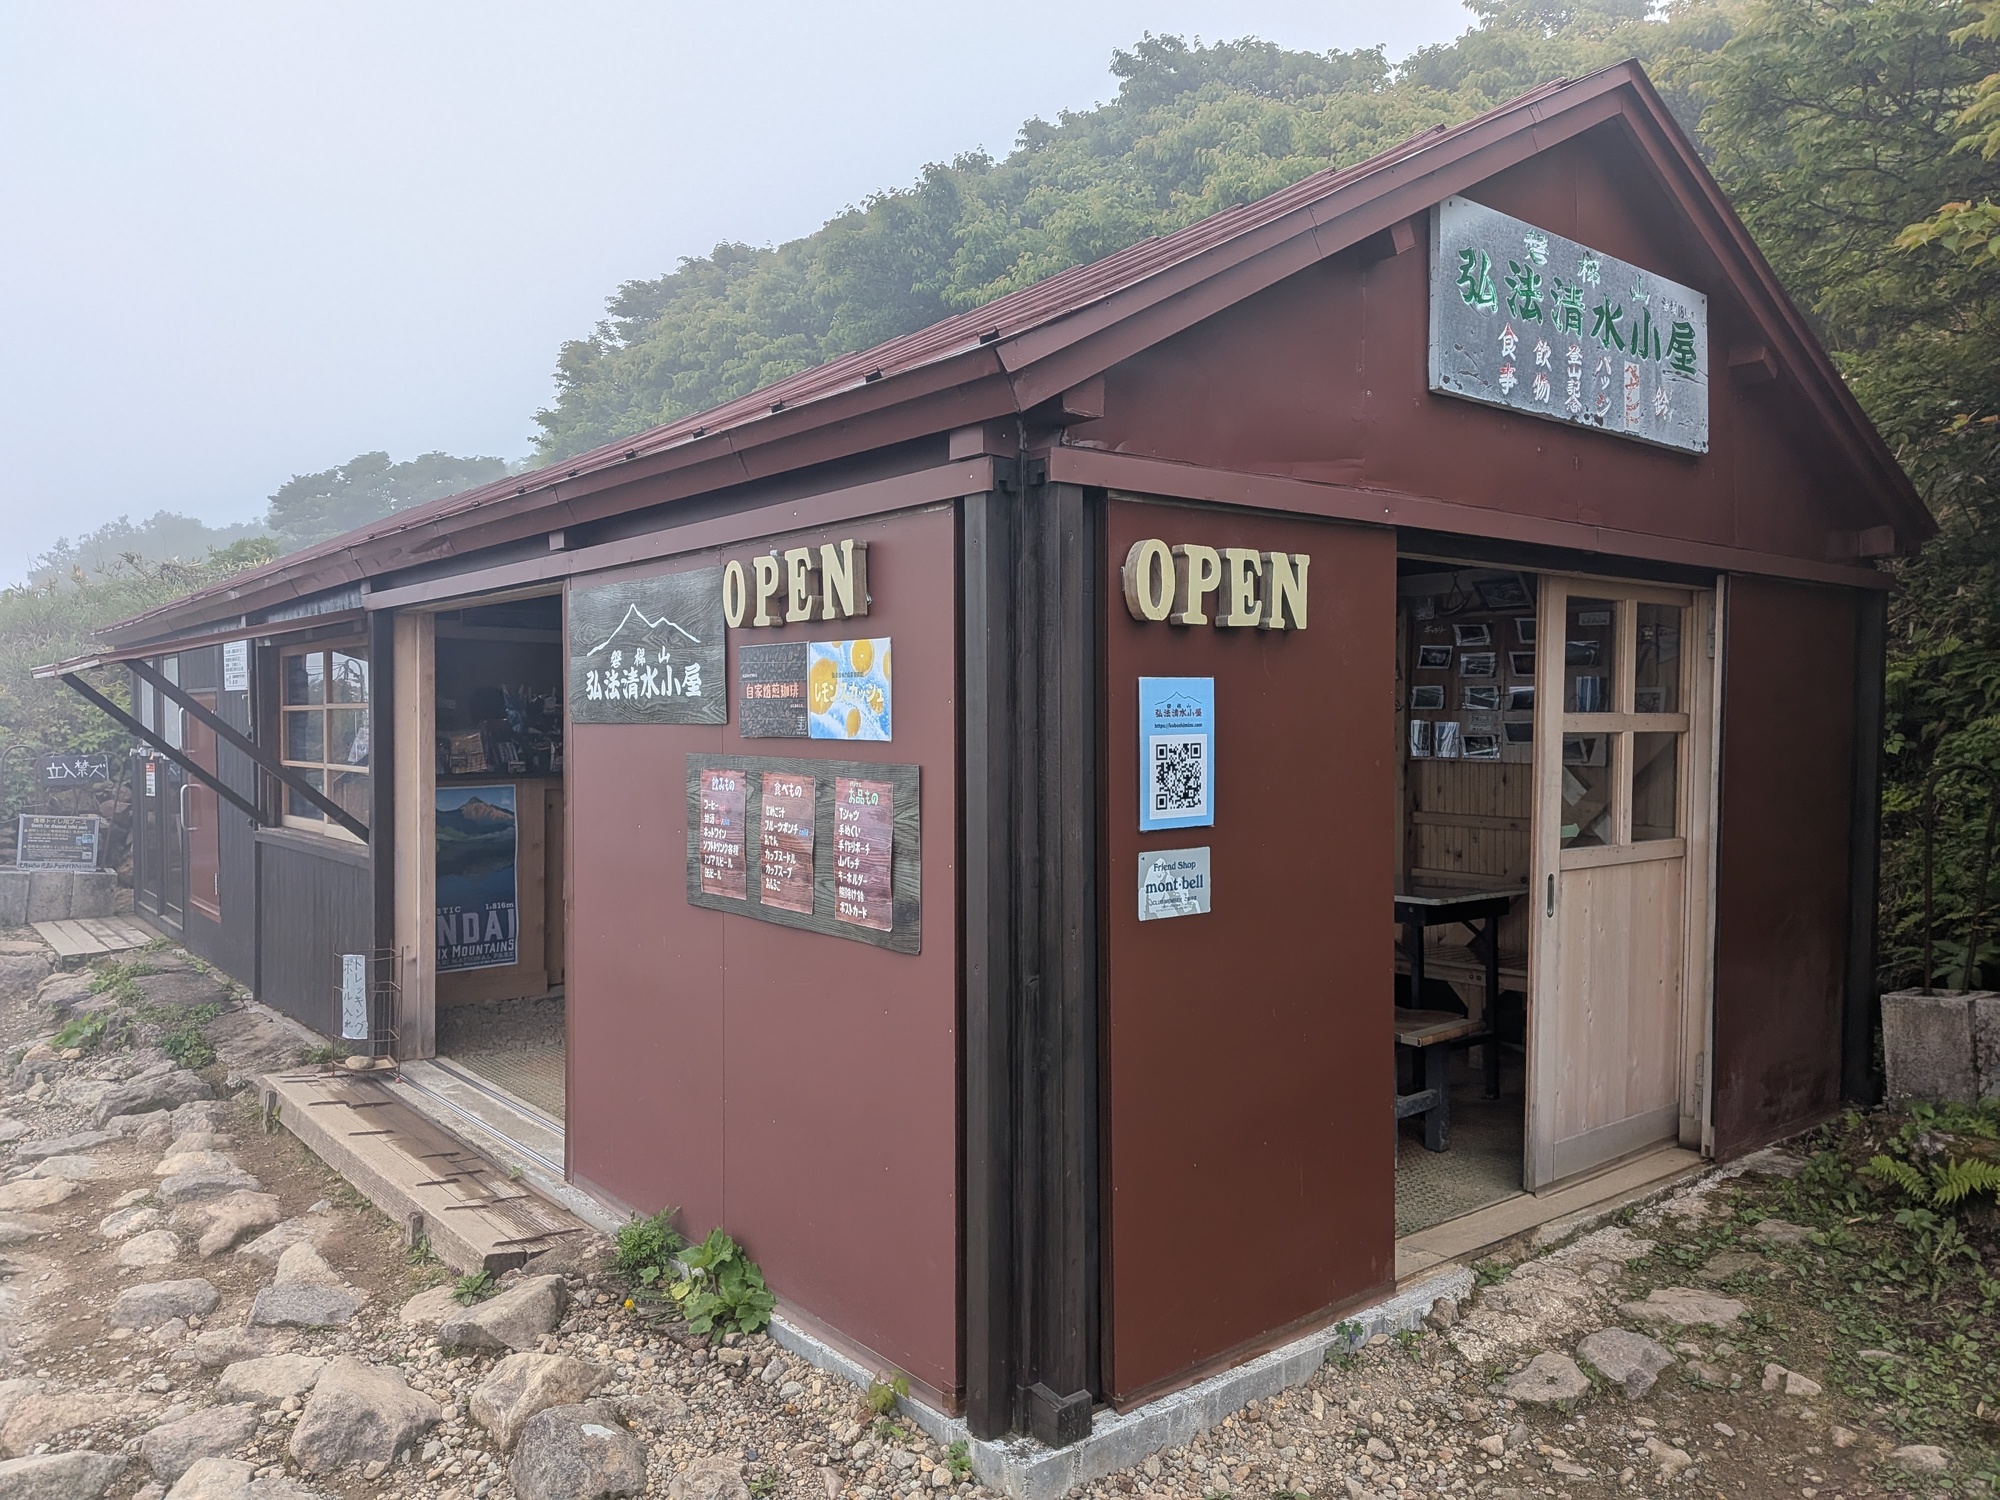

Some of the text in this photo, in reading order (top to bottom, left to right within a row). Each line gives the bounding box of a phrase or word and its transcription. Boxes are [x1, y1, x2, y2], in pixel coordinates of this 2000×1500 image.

[1457, 247, 1697, 376] 弘法清水小屋
[1498, 322, 1518, 396] 食事
[1533, 338, 1552, 404] 飲物
[1565, 344, 1583, 414] 登山記念
[723, 538, 855, 629] OPEN
[1135, 538, 1311, 630] OPEN
[611, 645, 671, 669] 磐梯山
[585, 662, 702, 701] 弘法清水小屋
[746, 682, 800, 699] 自家焙煎珈琲
[814, 682, 885, 703] レモンスカッシュ
[1155, 708, 1202, 718] 弘法清水小屋
[711, 777, 735, 792] 飲みもの
[774, 782, 803, 798] 食べもの
[703, 799, 719, 811] コーヒー
[848, 788, 879, 806] お品もの
[838, 807, 860, 821] Tシャツ
[764, 820, 799, 836] フルーツポンチ
[765, 863, 793, 879] カップスープ
[1153, 861, 1196, 872] Friend Shop
[839, 901, 868, 919] ポストカード
[355, 958, 366, 1036] トレッキング
